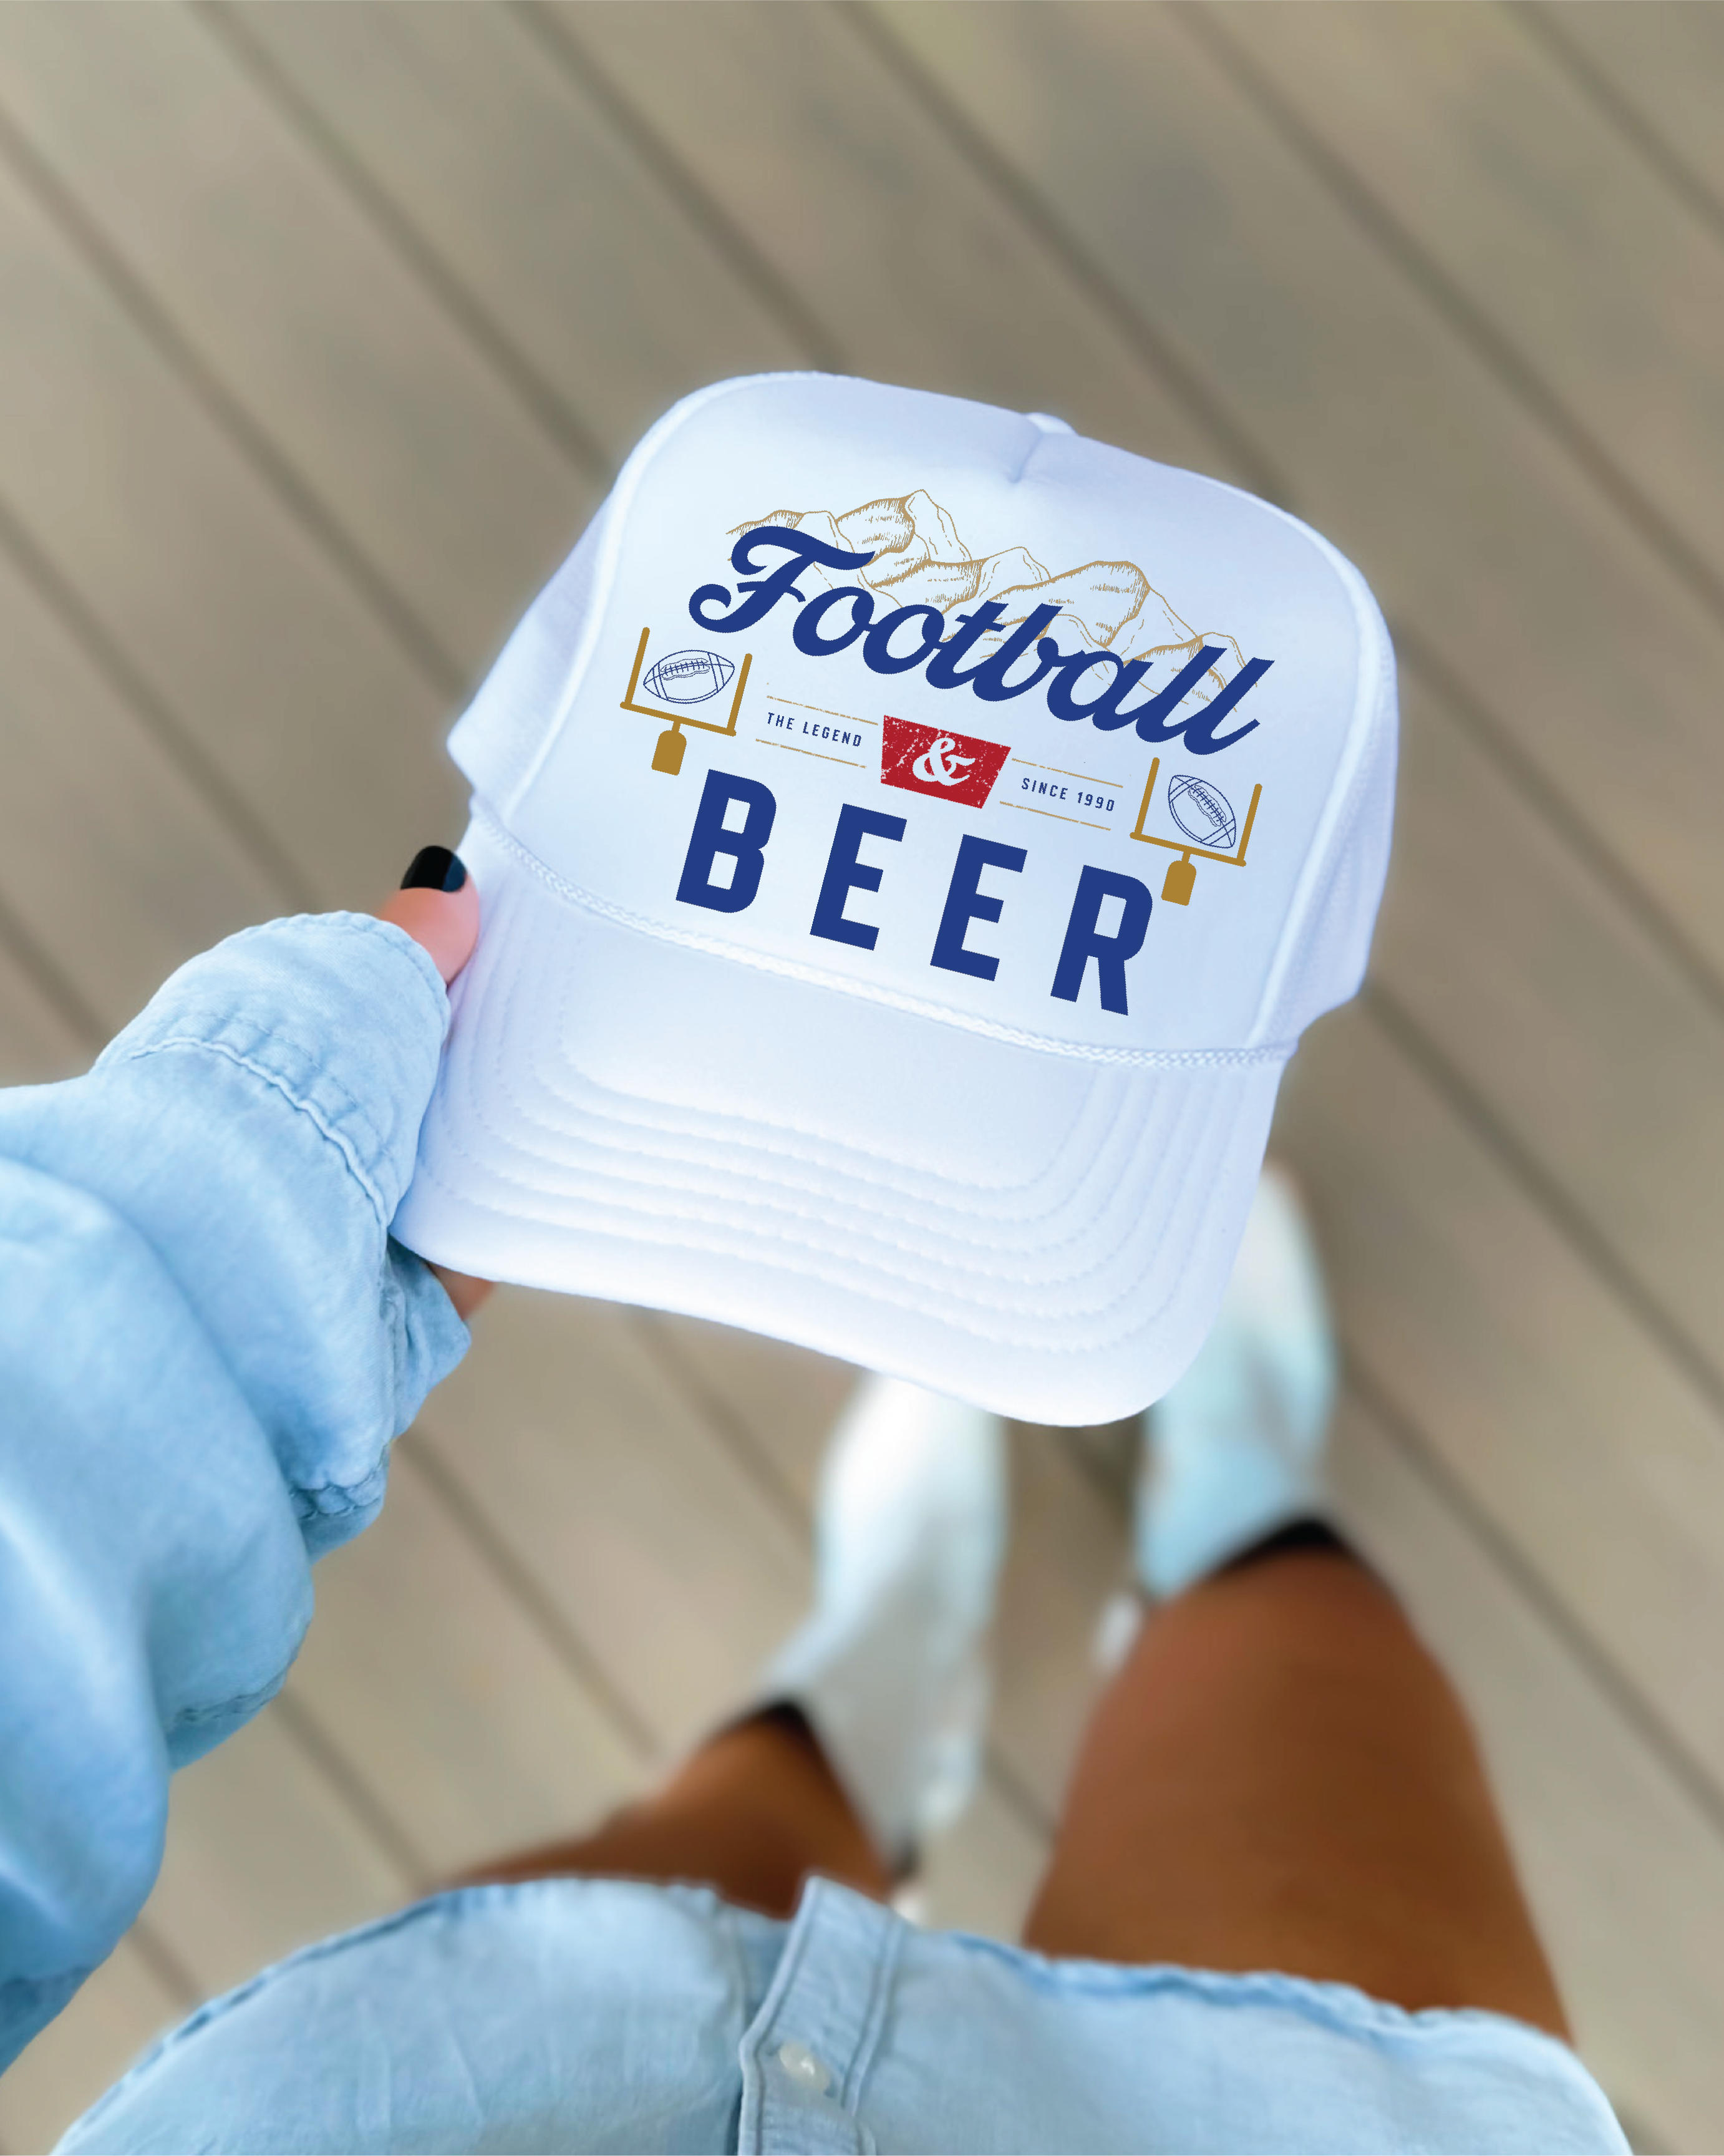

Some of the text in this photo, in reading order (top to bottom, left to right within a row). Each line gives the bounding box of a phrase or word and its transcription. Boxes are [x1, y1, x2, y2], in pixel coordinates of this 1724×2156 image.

[688, 525, 1275, 755] Football
[767, 711, 862, 747] THE LEGEND
[912, 737, 976, 787] &
[1020, 777, 1115, 812] SINCE 1990
[676, 769, 1153, 1016] BEER
